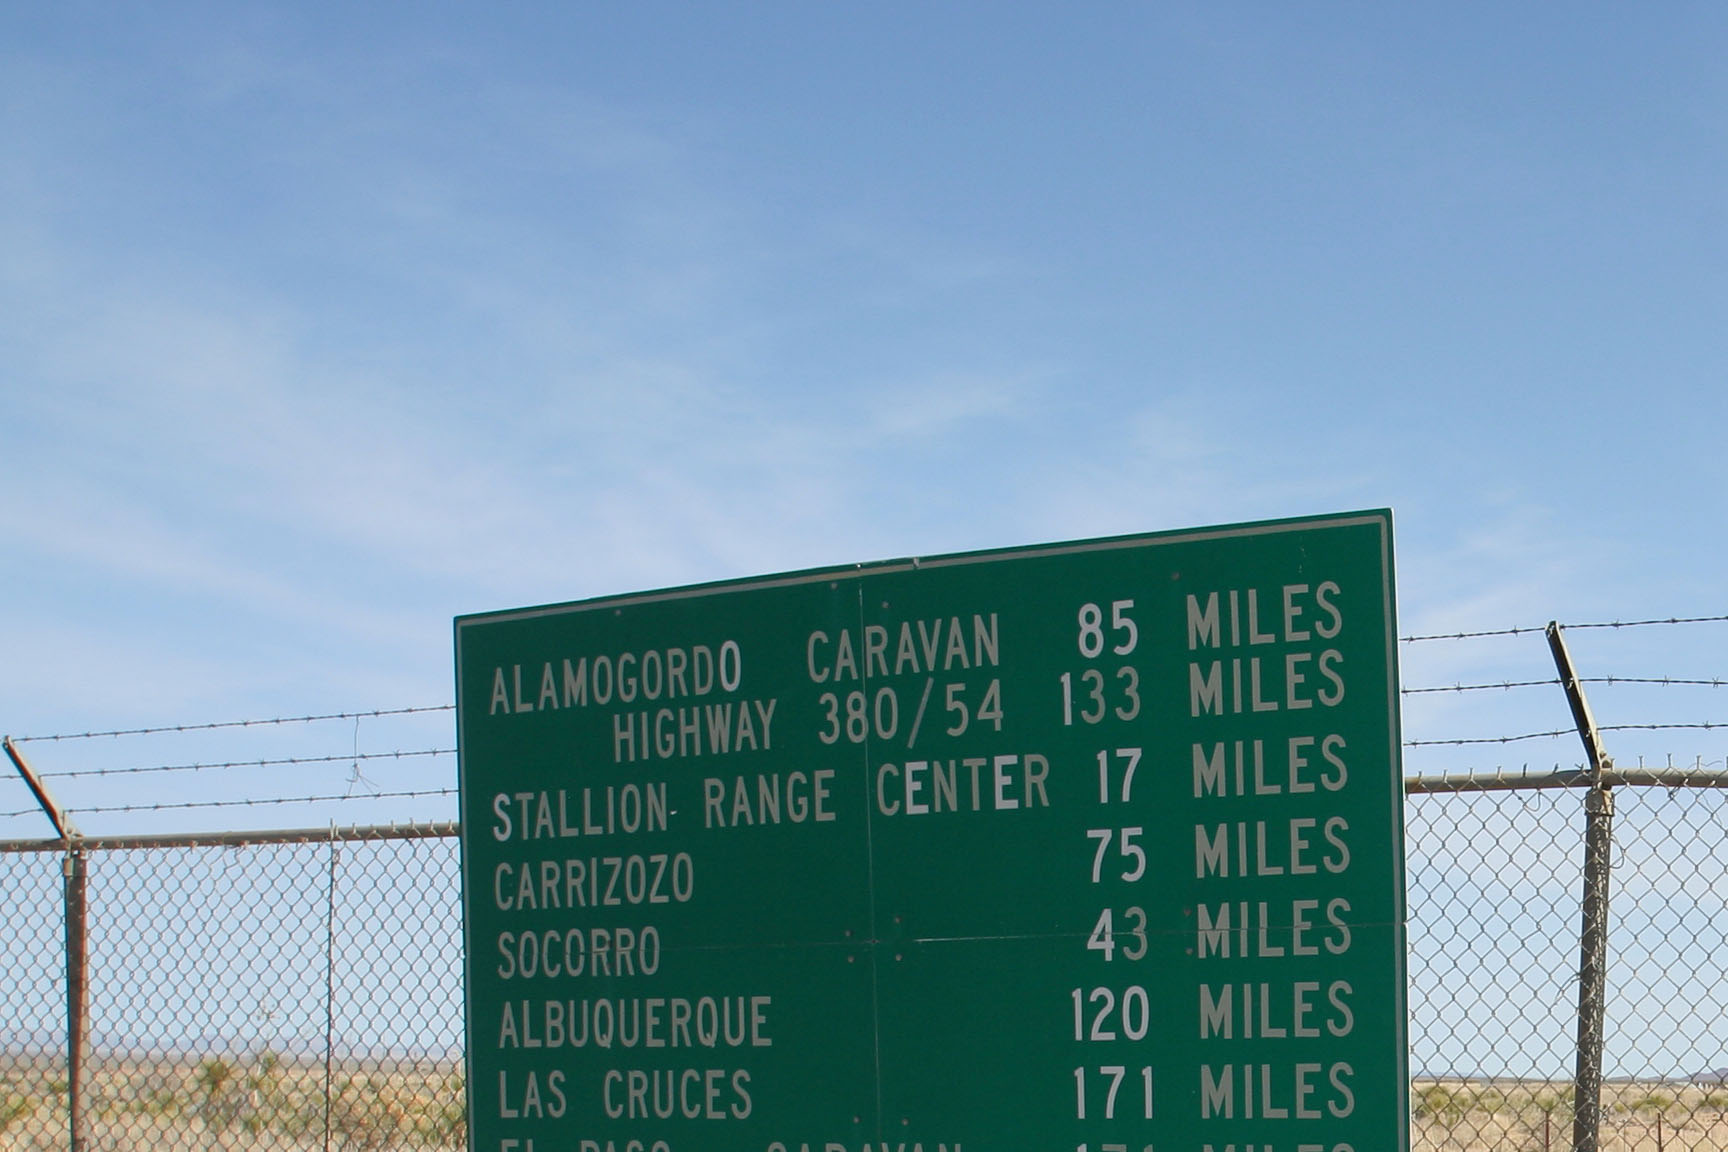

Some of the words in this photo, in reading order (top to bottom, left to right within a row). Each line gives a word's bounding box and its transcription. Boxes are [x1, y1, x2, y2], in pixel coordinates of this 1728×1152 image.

[491, 640, 741, 714] ALAMOGORDO
[808, 614, 998, 682] CARAVAN
[1078, 600, 1137, 658] 85
[1187, 581, 1342, 649] MILES
[614, 699, 776, 762] HIGHWAY
[819, 678, 1003, 747] 380/54
[1061, 666, 1140, 725] 133
[1190, 649, 1344, 716] MILES
[493, 784, 668, 841] STALLION
[705, 769, 835, 828] RANGE
[877, 754, 1050, 815] CENTER
[1097, 748, 1141, 803] 17
[1193, 734, 1347, 797] MILES
[495, 852, 693, 910] CARRIZOZO
[1087, 827, 1146, 883] 75
[1196, 816, 1350, 878] MILES
[498, 926, 659, 979] SOCORRO
[1087, 907, 1148, 961] 43
[1198, 898, 1351, 958] MILES
[500, 996, 772, 1048] ALBUQUERQUE
[1072, 986, 1149, 1041] 120
[1200, 981, 1353, 1039] MILES
[500, 1071, 566, 1118] LAS
[604, 1069, 752, 1119] CRUCES
[1074, 1065, 1153, 1119] 171
[1201, 1062, 1354, 1118] MILES
